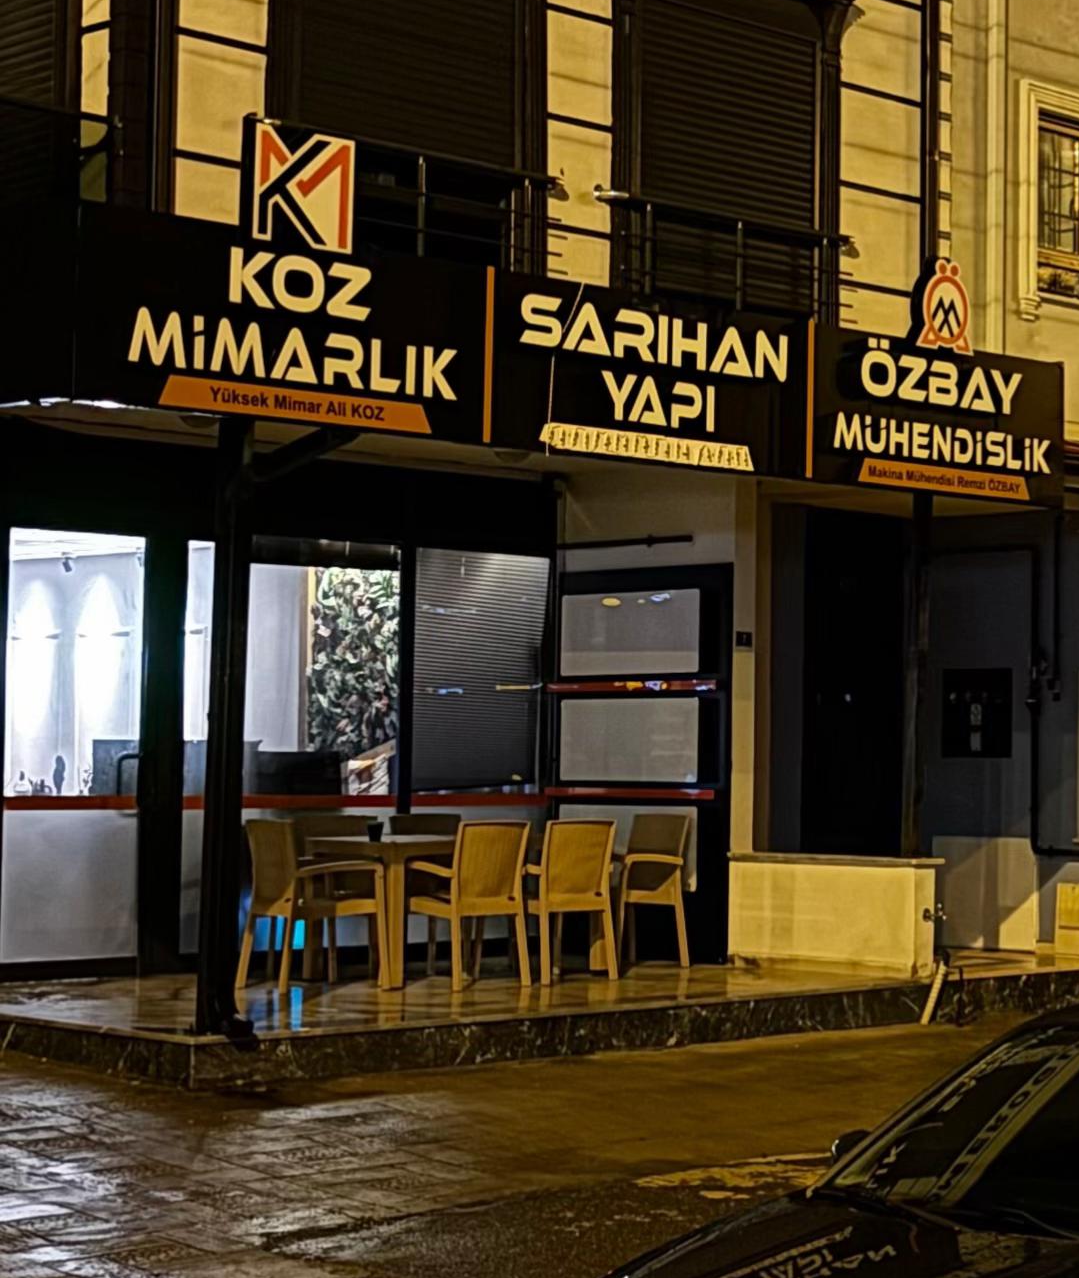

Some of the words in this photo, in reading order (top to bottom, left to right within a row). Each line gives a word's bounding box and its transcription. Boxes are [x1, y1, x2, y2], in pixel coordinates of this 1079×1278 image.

[229, 246, 372, 321] KOZ
[519, 293, 789, 383] SARIHAN
[210, 386, 268, 408] Yüksek
[274, 394, 320, 414] Mimar
[326, 400, 346, 417] Ali
[352, 405, 385, 421] KOZ
[601, 370, 716, 432] YAPI
[861, 337, 1023, 415] ÖZBAY
[988, 477, 1021, 495] ÖZBAY
